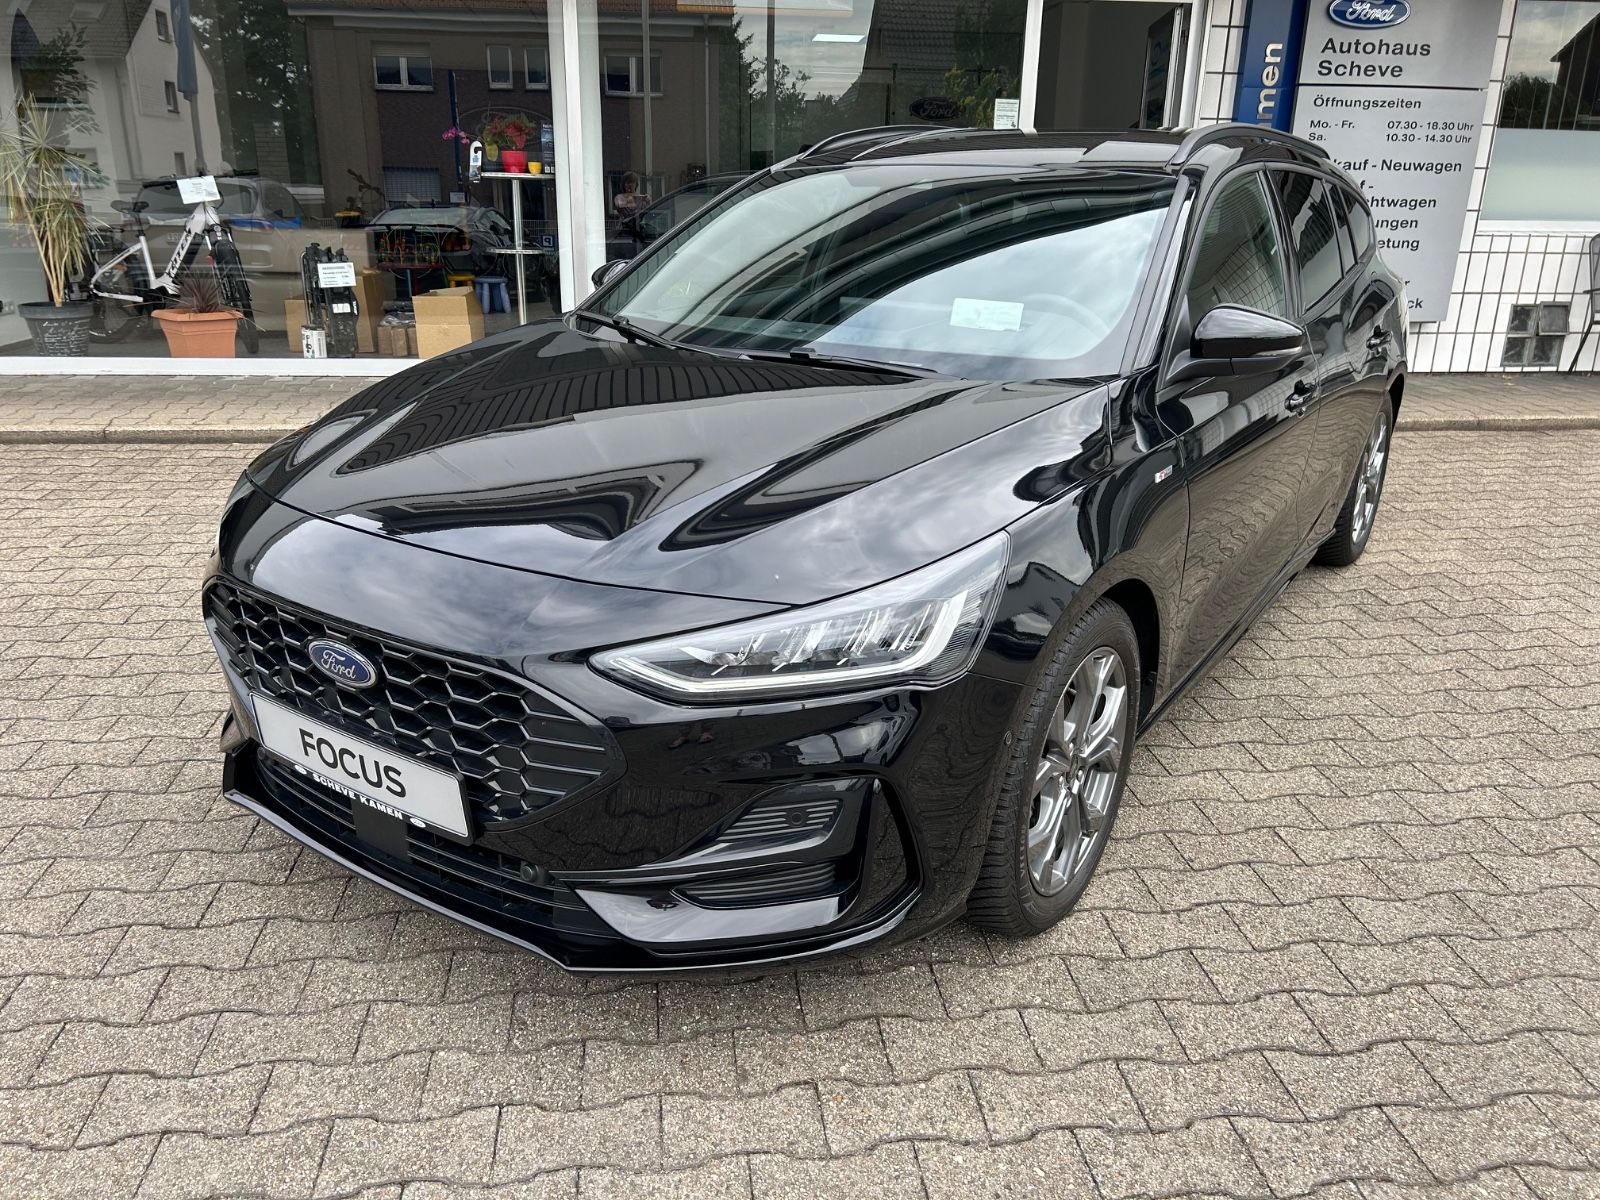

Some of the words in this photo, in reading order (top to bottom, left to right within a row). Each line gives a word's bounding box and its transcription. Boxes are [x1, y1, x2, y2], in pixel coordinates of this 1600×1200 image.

[1345, 0, 1397, 22] Ford
[1321, 37, 1431, 56] Autohaus
[1317, 59, 1403, 78] Scheve
[1313, 94, 1422, 110] Öffnungszeiten
[1309, 119, 1332, 129] Mo.
[1341, 119, 1355, 129] Fr.
[1387, 120, 1418, 130] 07.30
[1426, 121, 1455, 131] 18.30
[1457, 122, 1475, 132] Uhr
[1308, 132, 1327, 141] Sa.
[1385, 133, 1416, 142] 10.30
[1425, 134, 1453, 143] 14.30
[1455, 135, 1472, 144] Uhr
[1380, 159, 1462, 174] Neuwagen
[1367, 196, 1437, 211] htwagen
[1378, 238, 1420, 251] etung
[321, 650, 356, 679] Ford
[298, 727, 407, 798] FOCUS
[312, 773, 356, 800] SCHEVE
[360, 794, 403, 820] KAMEN
